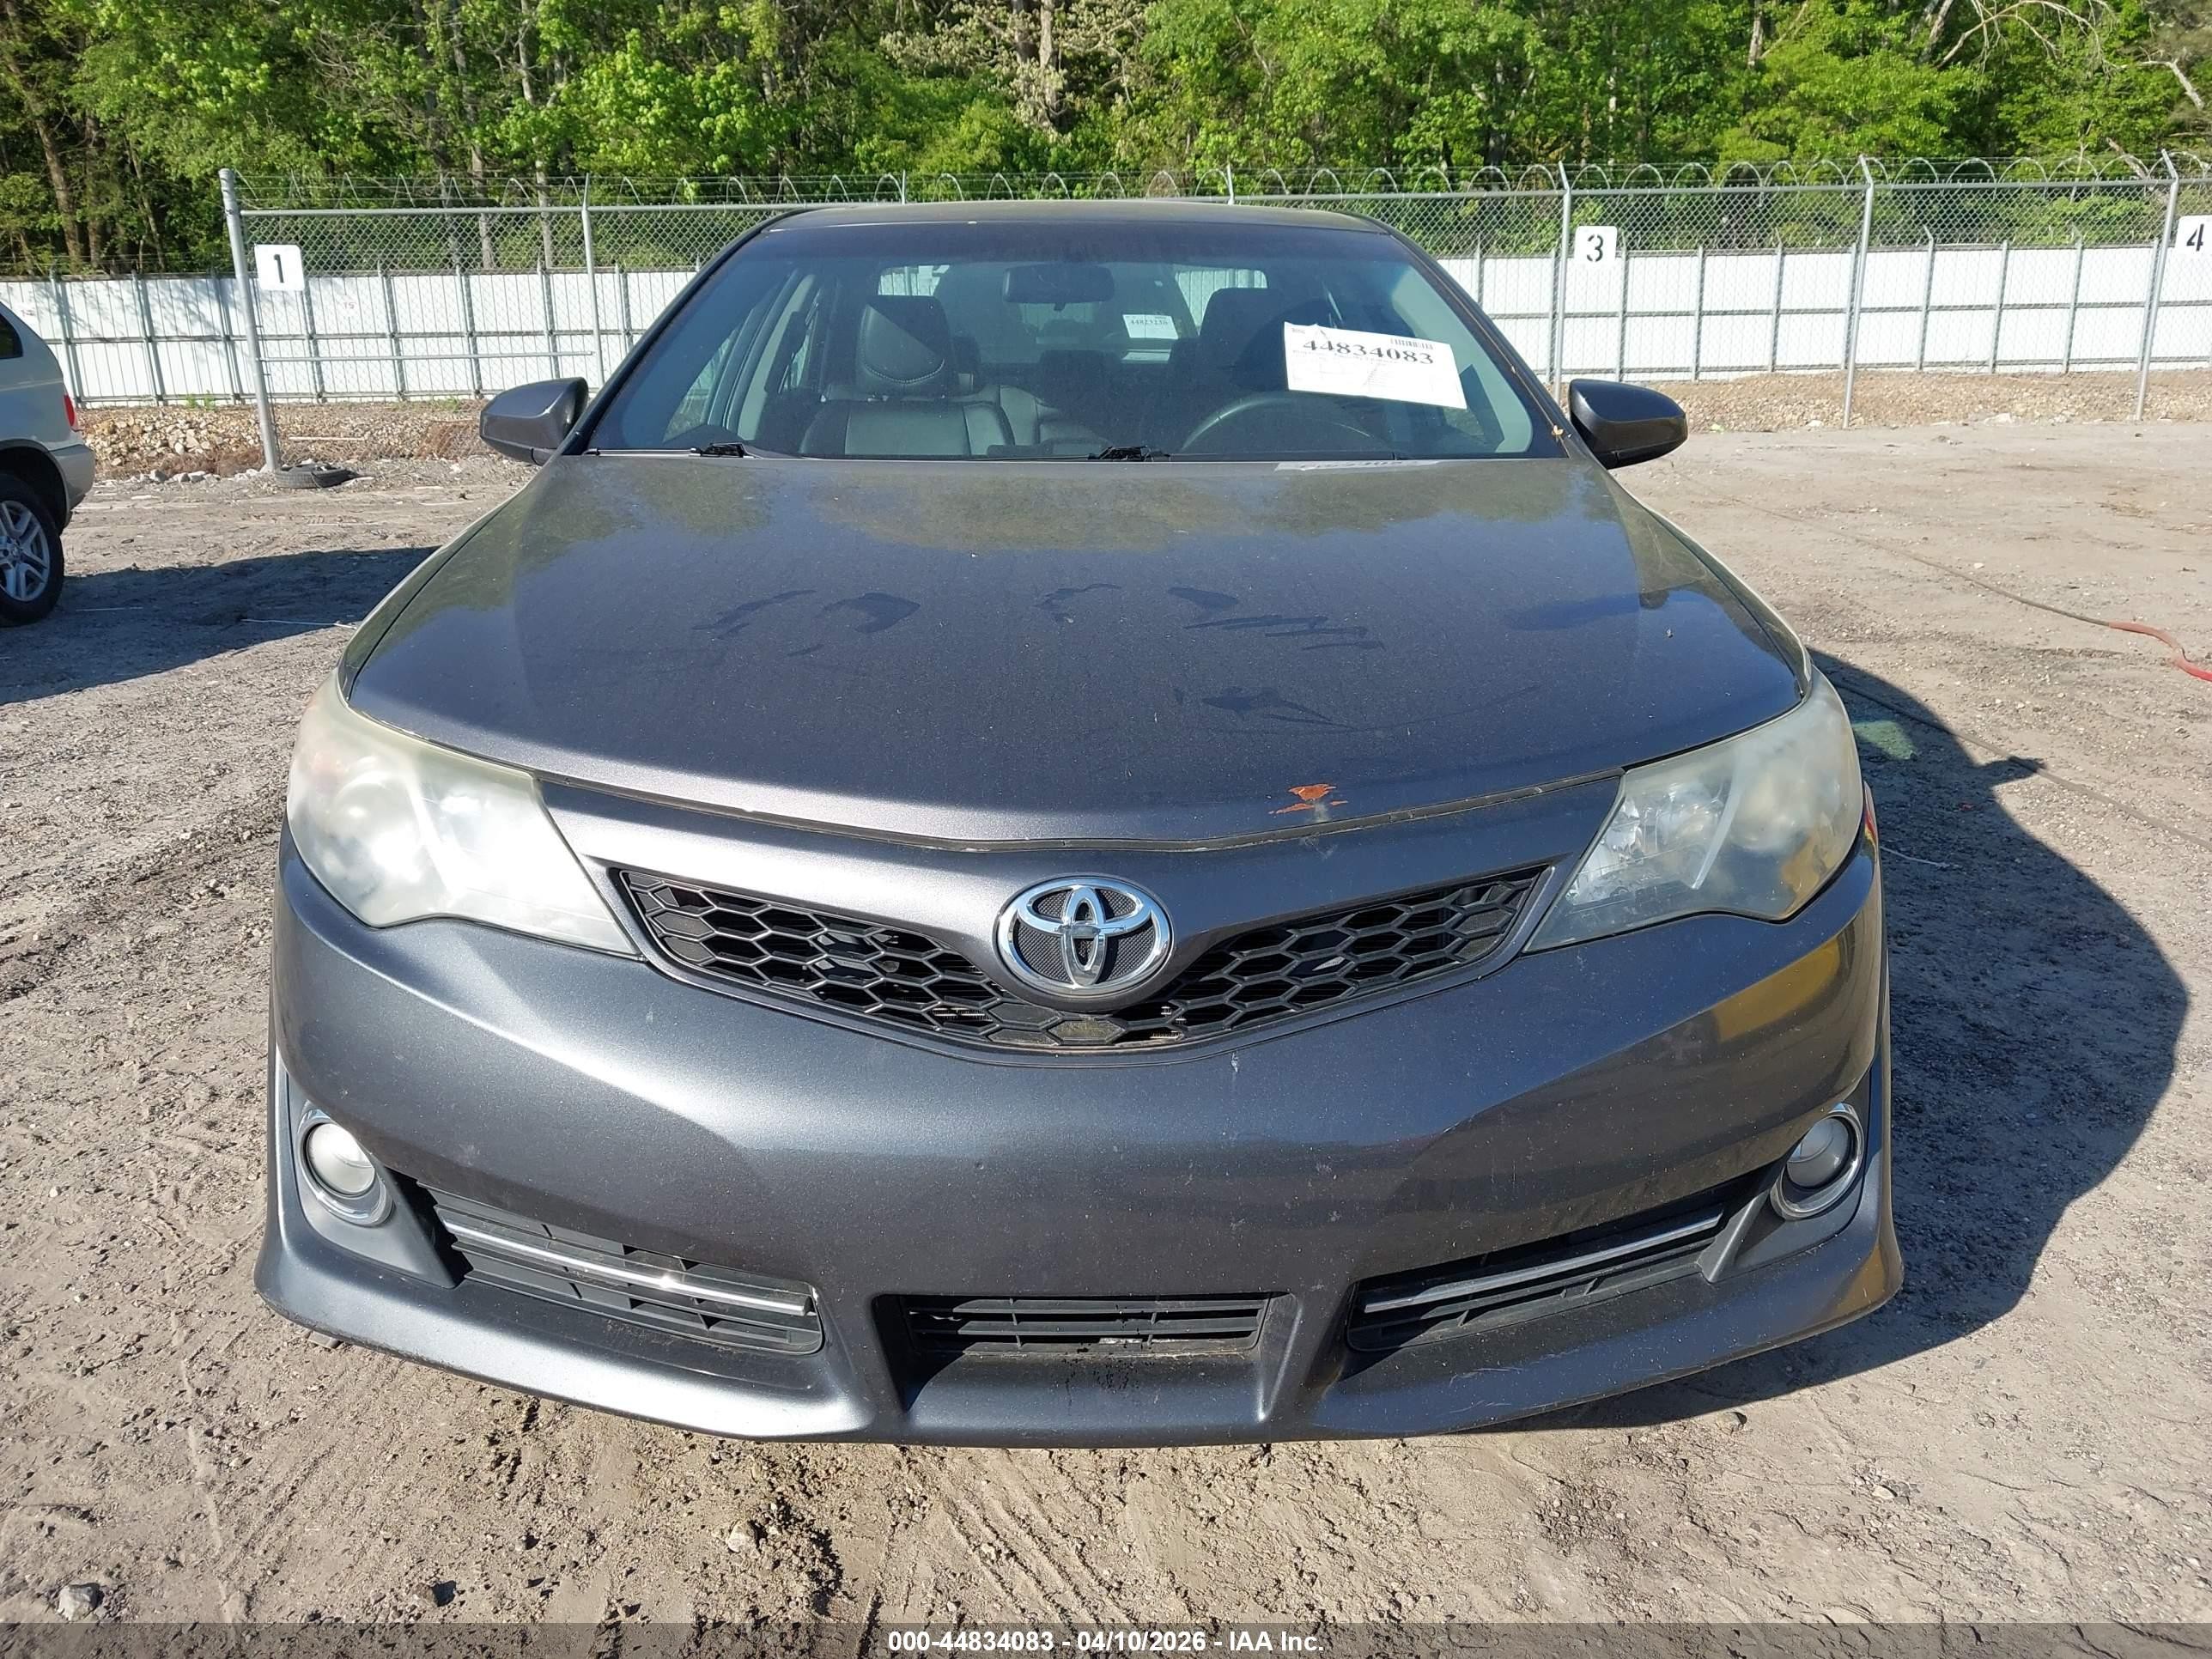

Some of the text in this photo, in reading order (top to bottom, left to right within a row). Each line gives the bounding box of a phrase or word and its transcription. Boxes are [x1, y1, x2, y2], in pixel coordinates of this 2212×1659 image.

[1587, 234, 1603, 262] 3
[2186, 223, 2205, 252] 4
[273, 253, 285, 283] 1
[1303, 340, 1434, 365] 44834083
